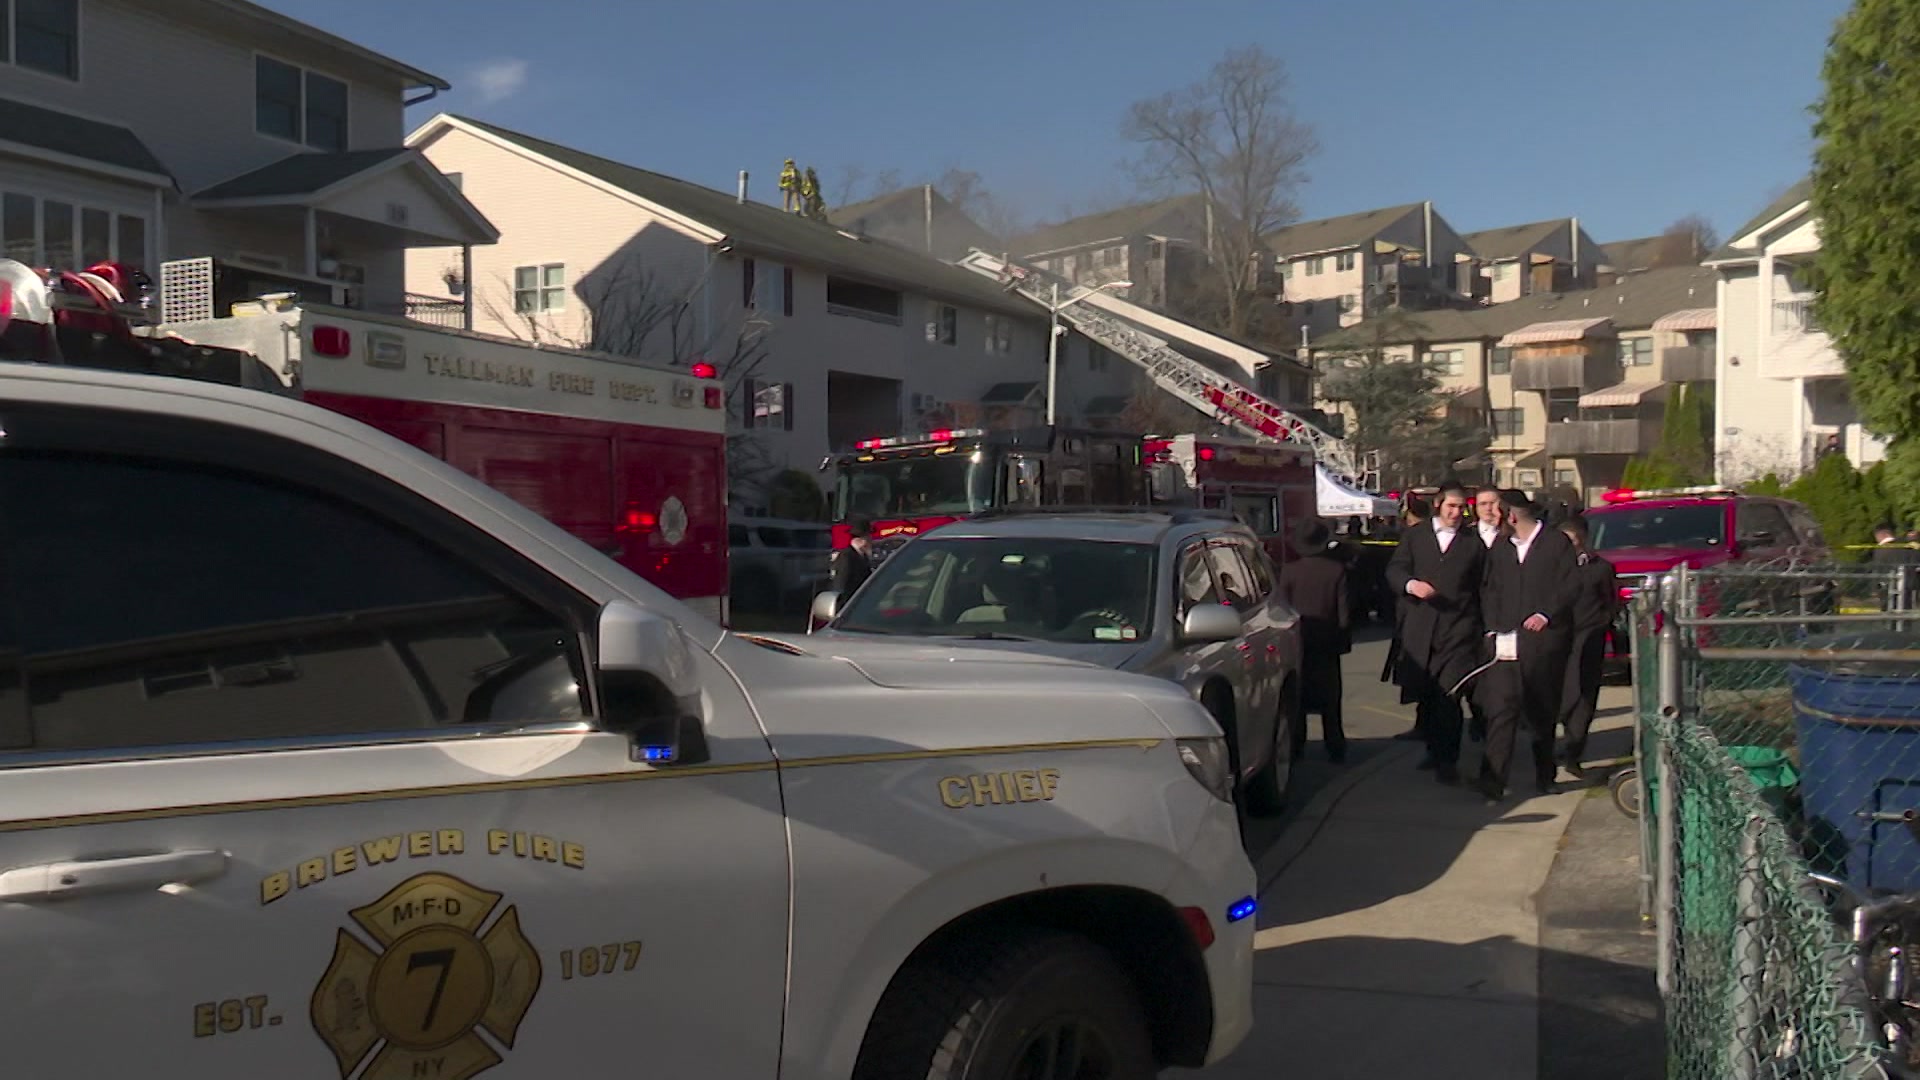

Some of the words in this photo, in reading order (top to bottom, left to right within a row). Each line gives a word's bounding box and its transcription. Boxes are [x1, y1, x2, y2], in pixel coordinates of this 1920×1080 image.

[423, 353, 534, 388] TALLMAN
[549, 371, 596, 396] FIRE
[938, 768, 1061, 809] CHIEF
[260, 829, 465, 905] BREWER
[488, 829, 586, 870] FIRE
[560, 941, 643, 980] 1877
[406, 947, 457, 1032] 7
[193, 995, 283, 1038] EST.
[412, 1058, 446, 1078] NY
